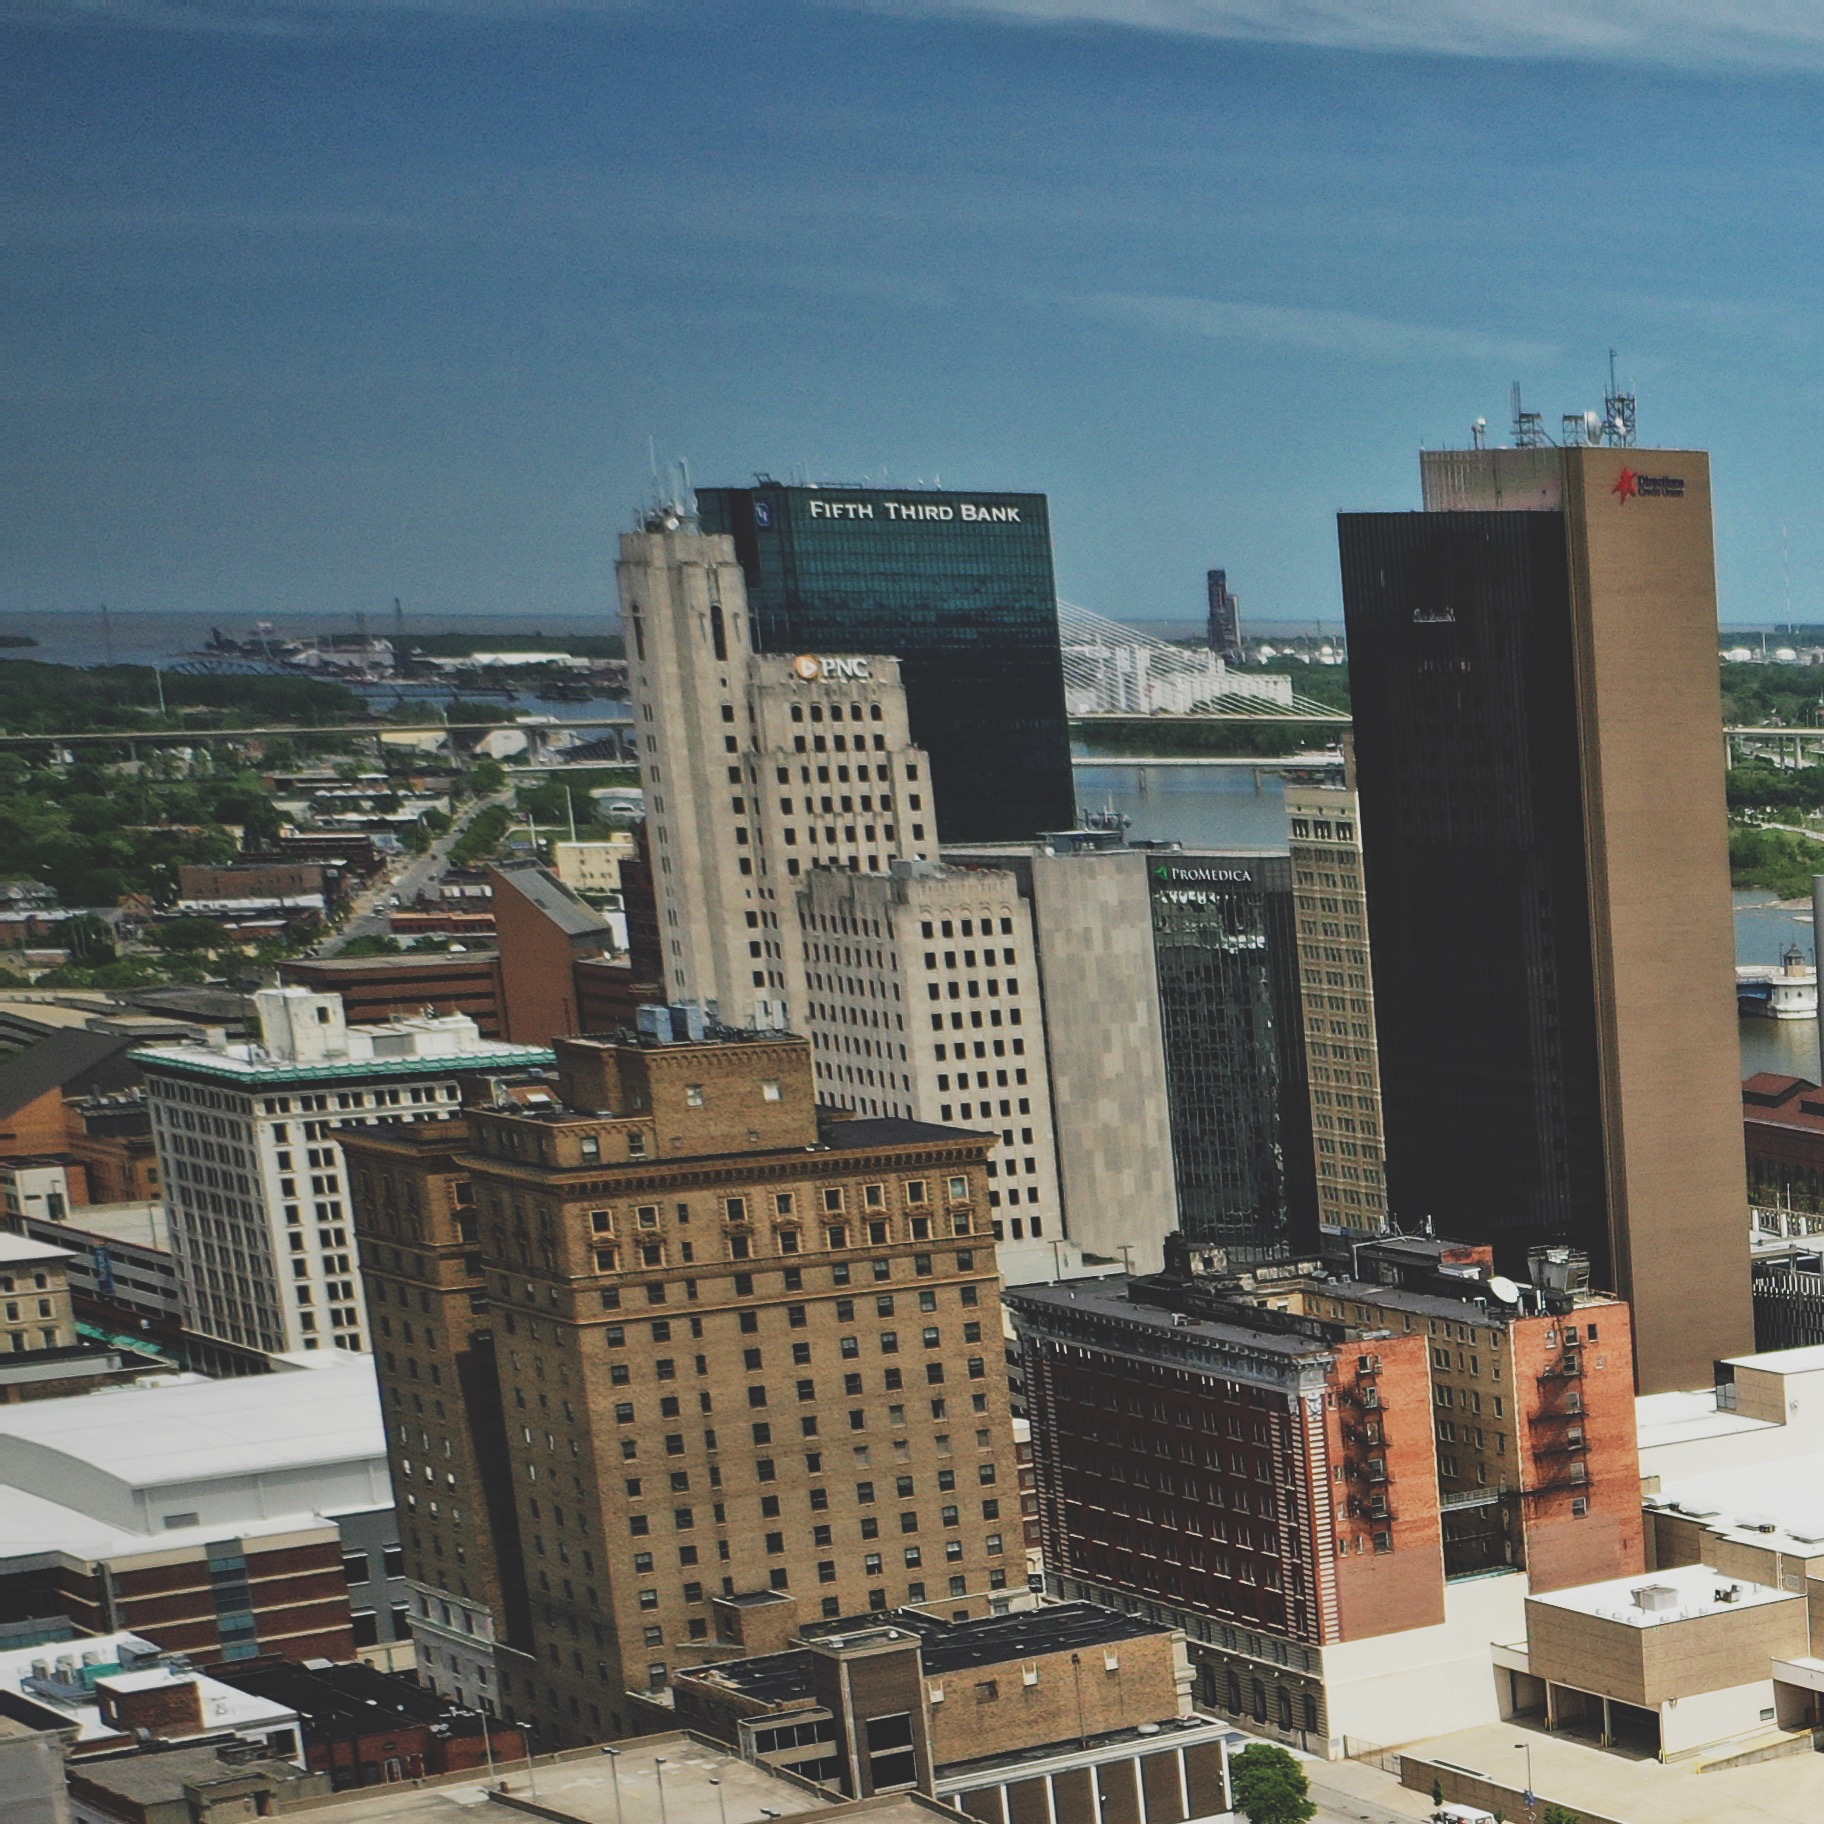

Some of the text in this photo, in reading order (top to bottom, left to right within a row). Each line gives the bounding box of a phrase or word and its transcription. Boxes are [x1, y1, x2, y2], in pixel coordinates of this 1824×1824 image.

[810, 501, 1021, 522] FIFTH THIRD BANK
[821, 658, 869, 677] PNC
